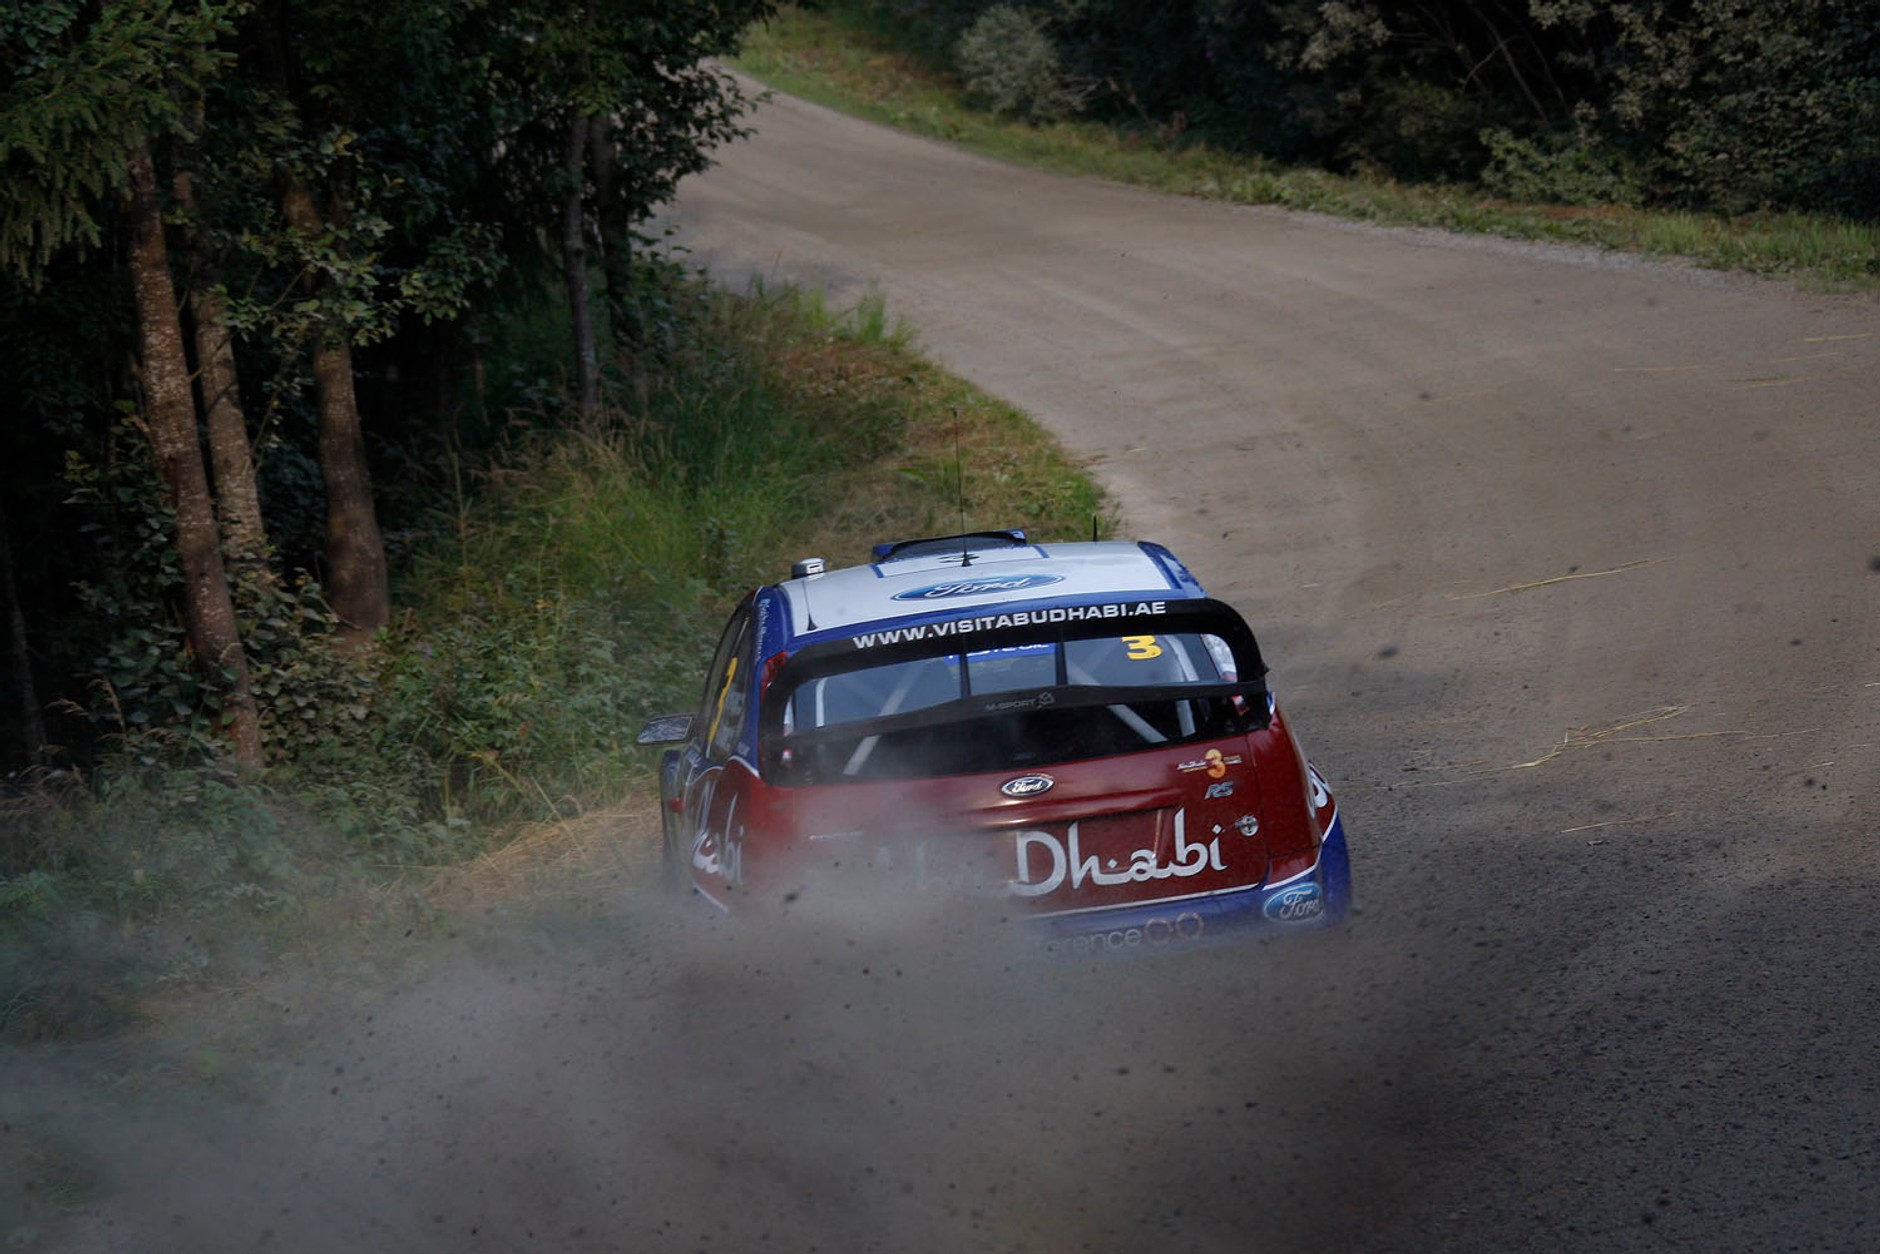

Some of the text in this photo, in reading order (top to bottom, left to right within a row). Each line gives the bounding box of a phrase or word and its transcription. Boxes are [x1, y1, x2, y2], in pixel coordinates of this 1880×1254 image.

[924, 577, 1031, 598] Ford
[852, 600, 1167, 650] WWW.VISITABUDHABI.AE
[1121, 635, 1163, 661] 3
[1205, 749, 1226, 778] 3
[1204, 781, 1234, 800] RS
[1008, 807, 1229, 896] Dhabi
